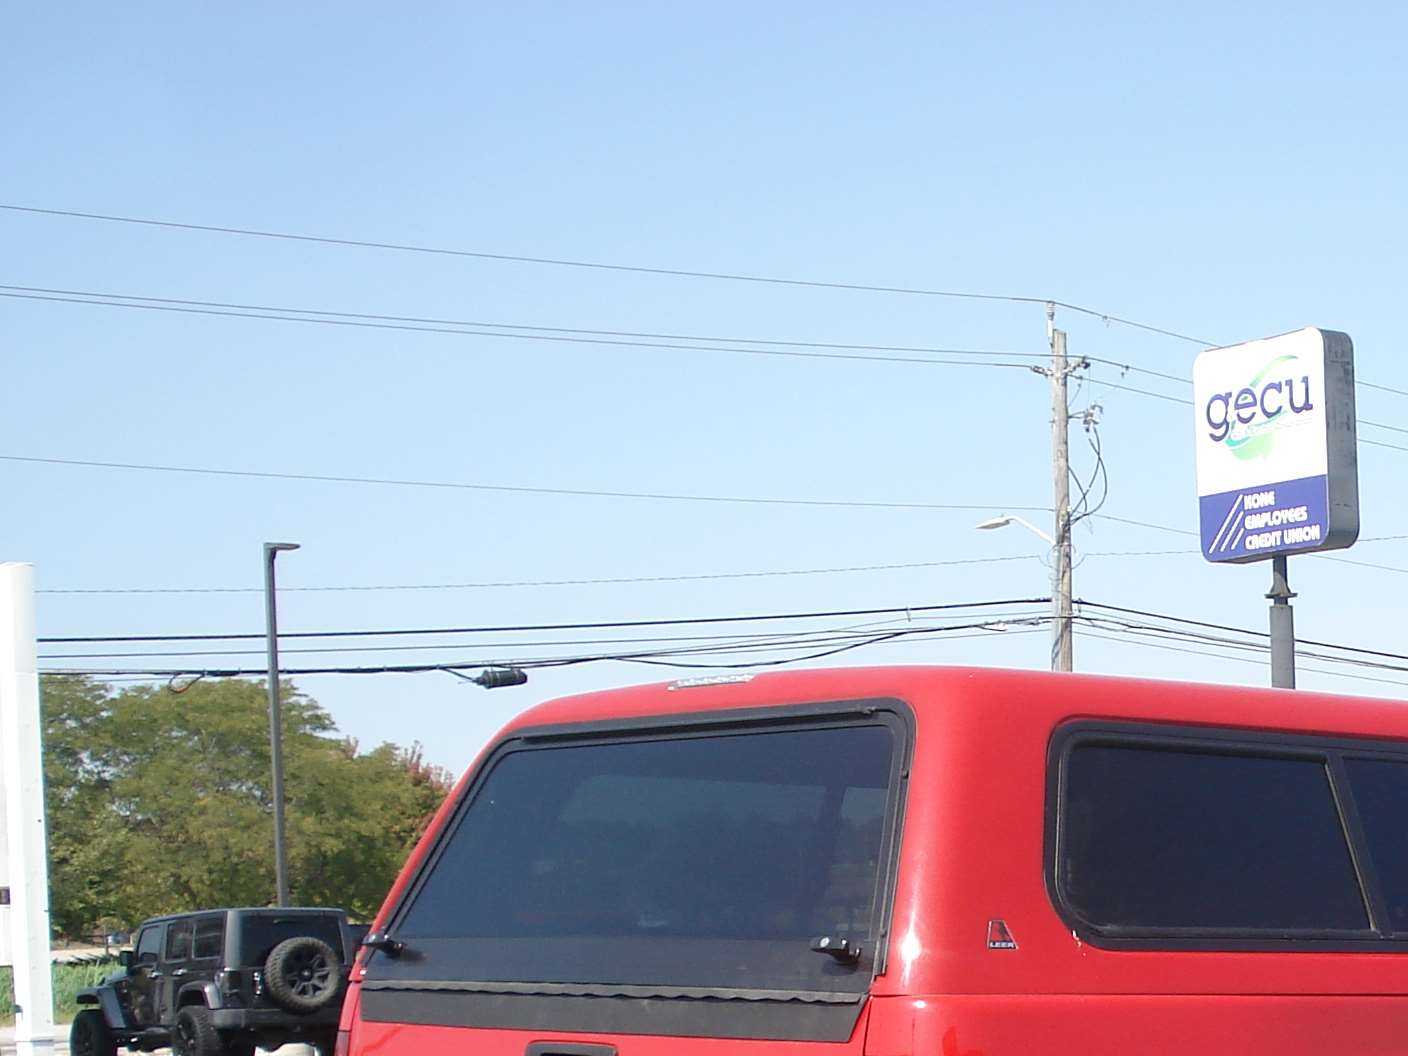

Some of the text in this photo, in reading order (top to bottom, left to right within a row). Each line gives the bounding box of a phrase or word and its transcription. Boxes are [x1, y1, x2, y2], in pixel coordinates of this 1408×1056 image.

[1206, 376, 1313, 442] gecu
[1244, 506, 1308, 529] EMPLOYEES
[1245, 524, 1320, 550] CREDIT UNION
